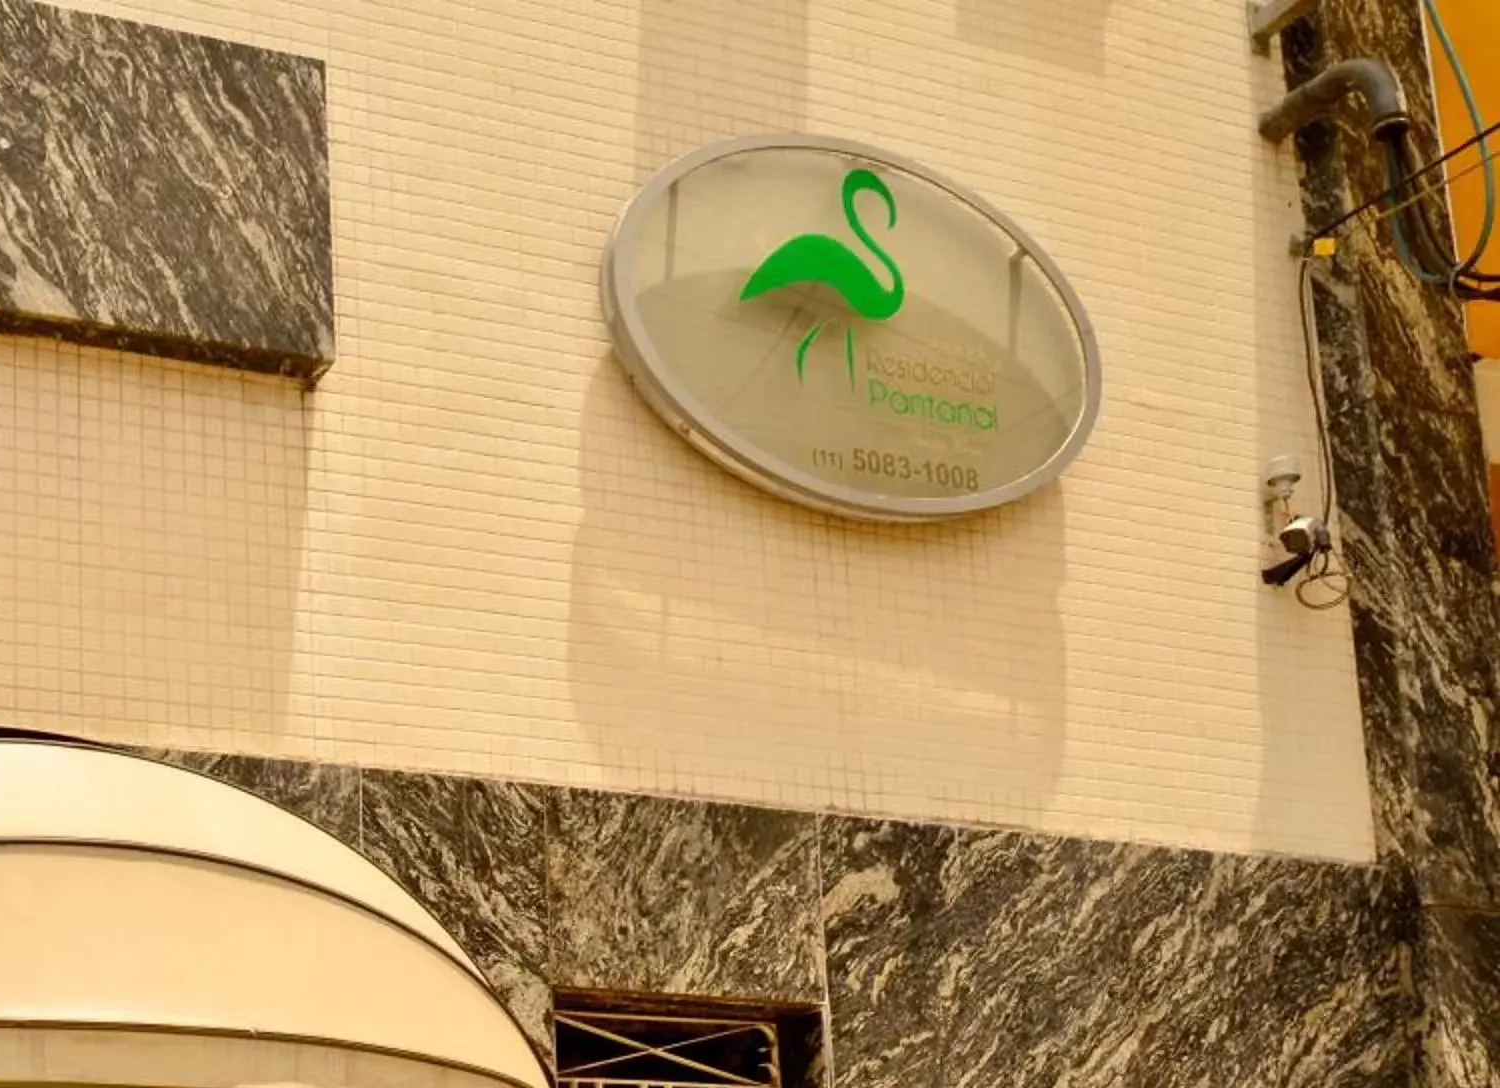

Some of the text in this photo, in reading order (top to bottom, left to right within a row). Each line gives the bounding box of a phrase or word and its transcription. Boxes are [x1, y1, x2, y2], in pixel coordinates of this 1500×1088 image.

[868, 378, 998, 432] Pantanal
[812, 448, 979, 492] (11) 5083-1008
